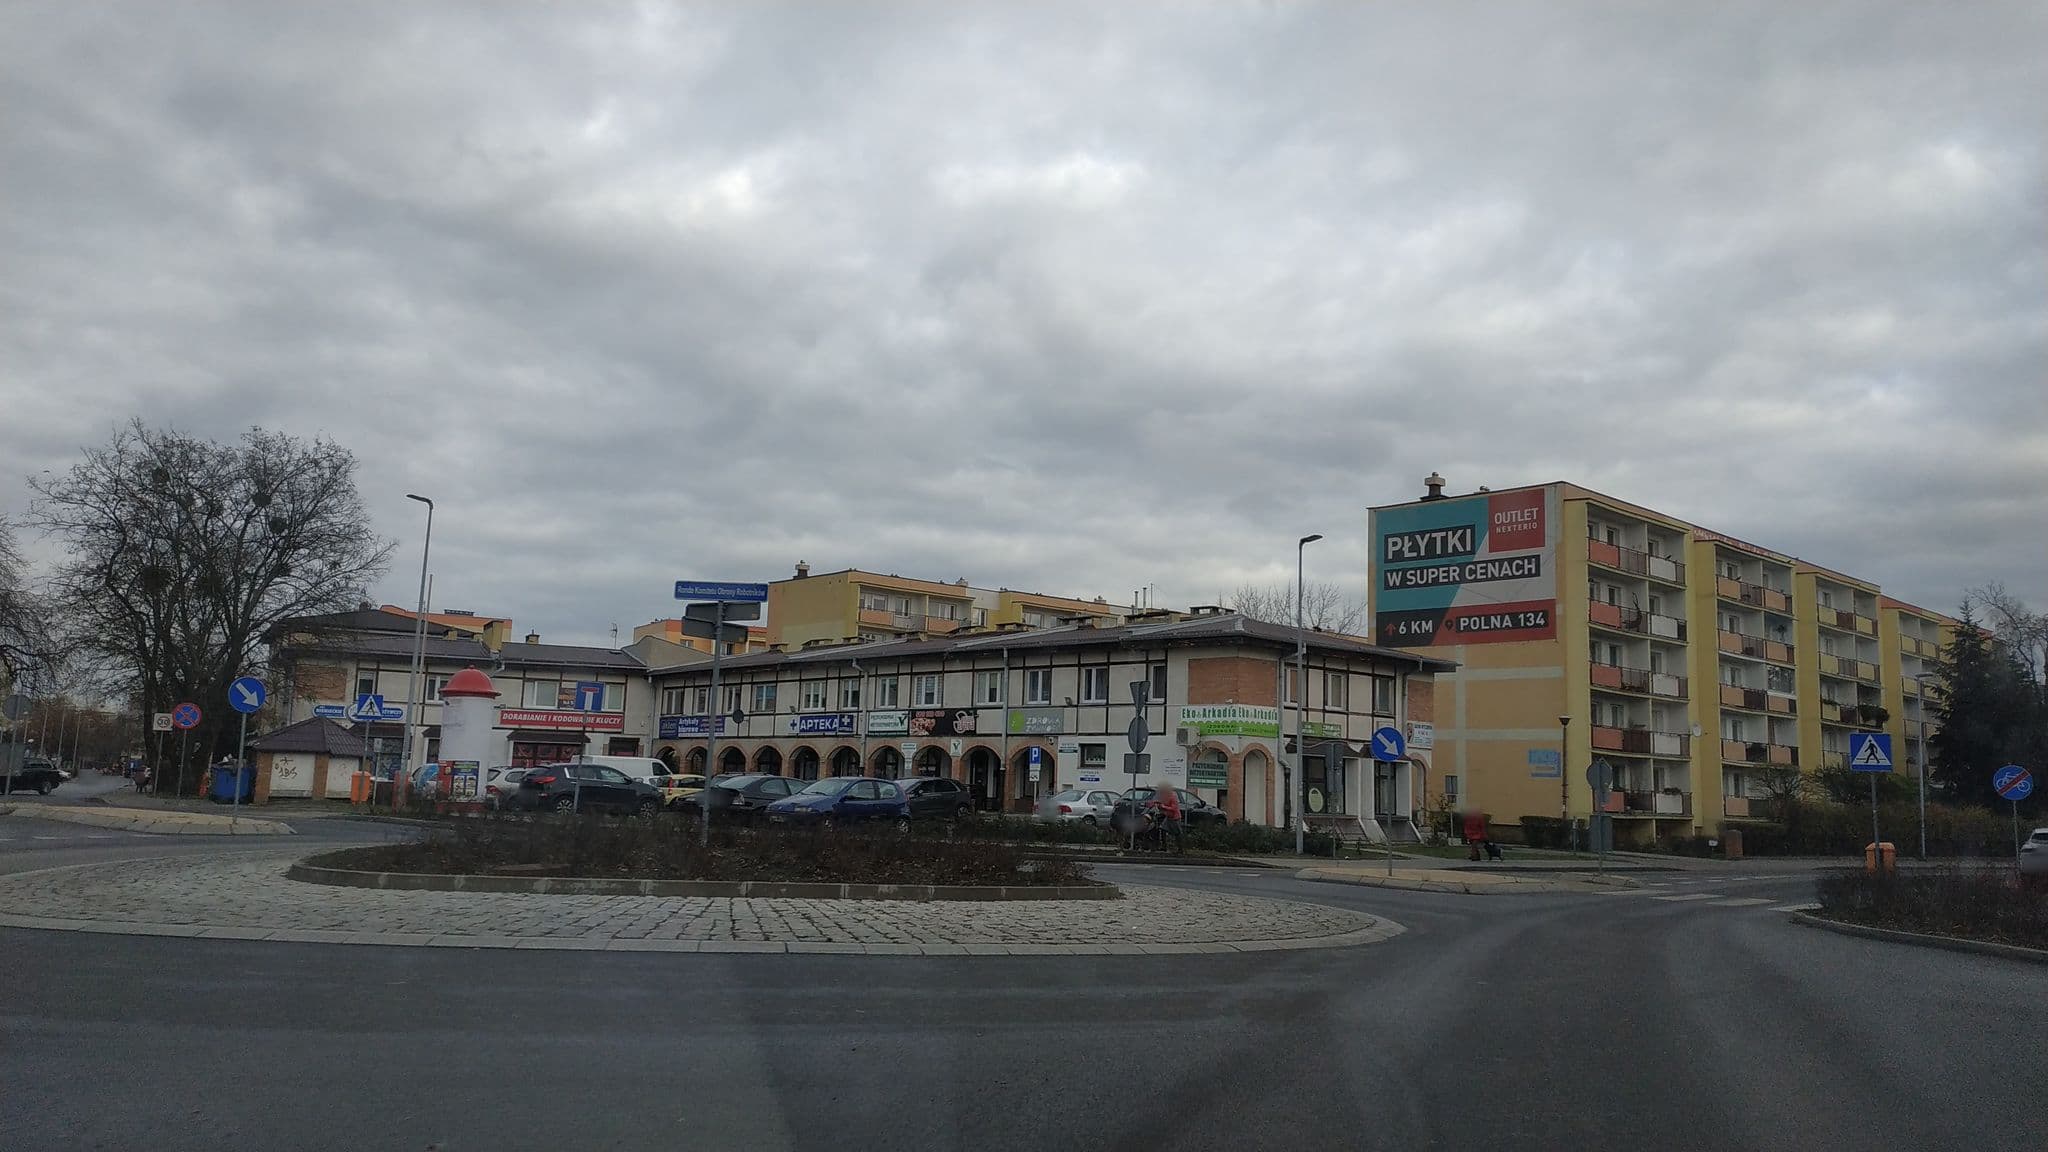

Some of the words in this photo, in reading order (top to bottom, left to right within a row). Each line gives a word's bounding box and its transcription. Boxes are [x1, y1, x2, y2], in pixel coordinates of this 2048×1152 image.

[1495, 508, 1538, 524] OUTLET
[1496, 522, 1538, 533] NEXTERIO
[1387, 529, 1472, 560] PŁYTKI
[1387, 572, 1402, 587] W
[1406, 566, 1460, 586] SUPER
[1465, 558, 1536, 580] CENACH
[678, 586, 694, 594] Rondo
[717, 587, 736, 597] Obrony
[1398, 622, 1406, 635] 6
[1411, 620, 1433, 634] KM
[1460, 614, 1512, 631] POLNA
[1518, 612, 1545, 627] 134
[1182, 708, 1196, 718] Eko
[1202, 706, 1236, 718] Arkadia
[800, 719, 839, 730] APTEKA
[1032, 747, 1039, 761] P
